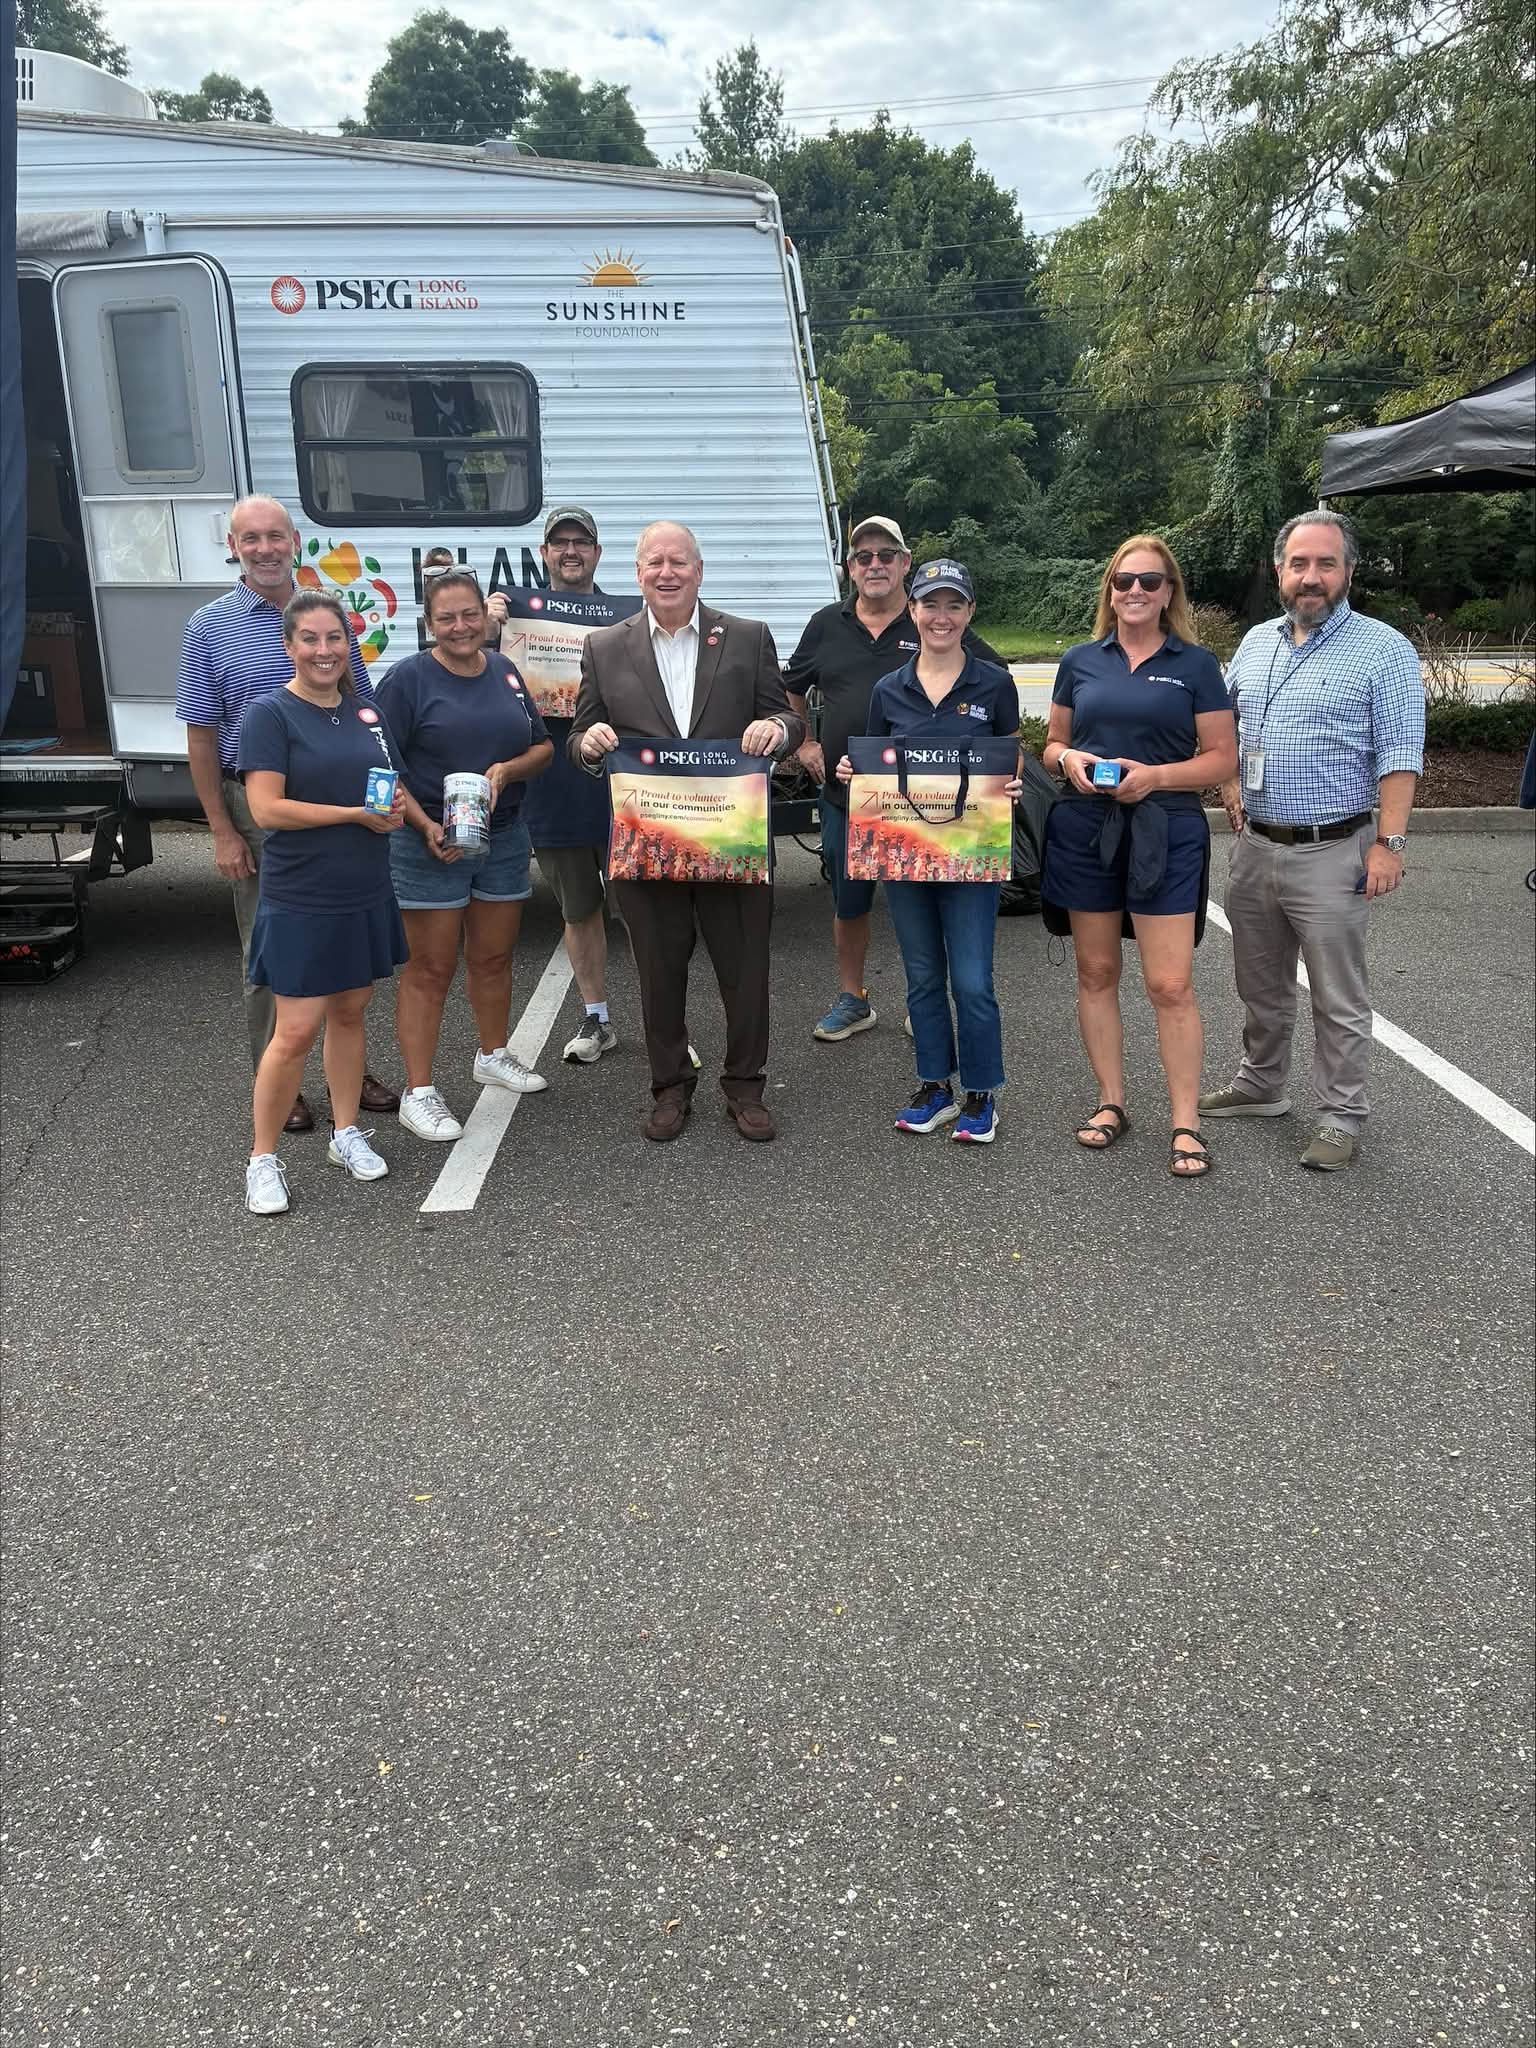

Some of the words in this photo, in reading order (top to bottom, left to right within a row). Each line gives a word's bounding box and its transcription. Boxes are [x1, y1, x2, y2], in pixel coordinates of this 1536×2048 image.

[418, 280, 467, 293] LONG
[316, 279, 412, 310] PSEG
[607, 289, 625, 298] THE
[419, 297, 479, 310] ISLAND
[546, 302, 686, 321] SUNSHINE
[575, 326, 660, 338] FOUNDATION
[546, 600, 582, 615] PSEG
[529, 633, 554, 643] Proud
[556, 635, 565, 643] to
[529, 643, 537, 651] in
[555, 646, 582, 655] comm
[659, 751, 700, 765] PSEG
[904, 749, 944, 763] PSEG
[641, 790, 670, 800] Proud
[672, 793, 681, 801] to
[684, 793, 727, 802] volunteer
[882, 791, 910, 800] Pro
[912, 792, 922, 800] to
[640, 799, 650, 807] in
[652, 801, 669, 809] our
[672, 803, 736, 812] communities
[882, 801, 891, 810] in
